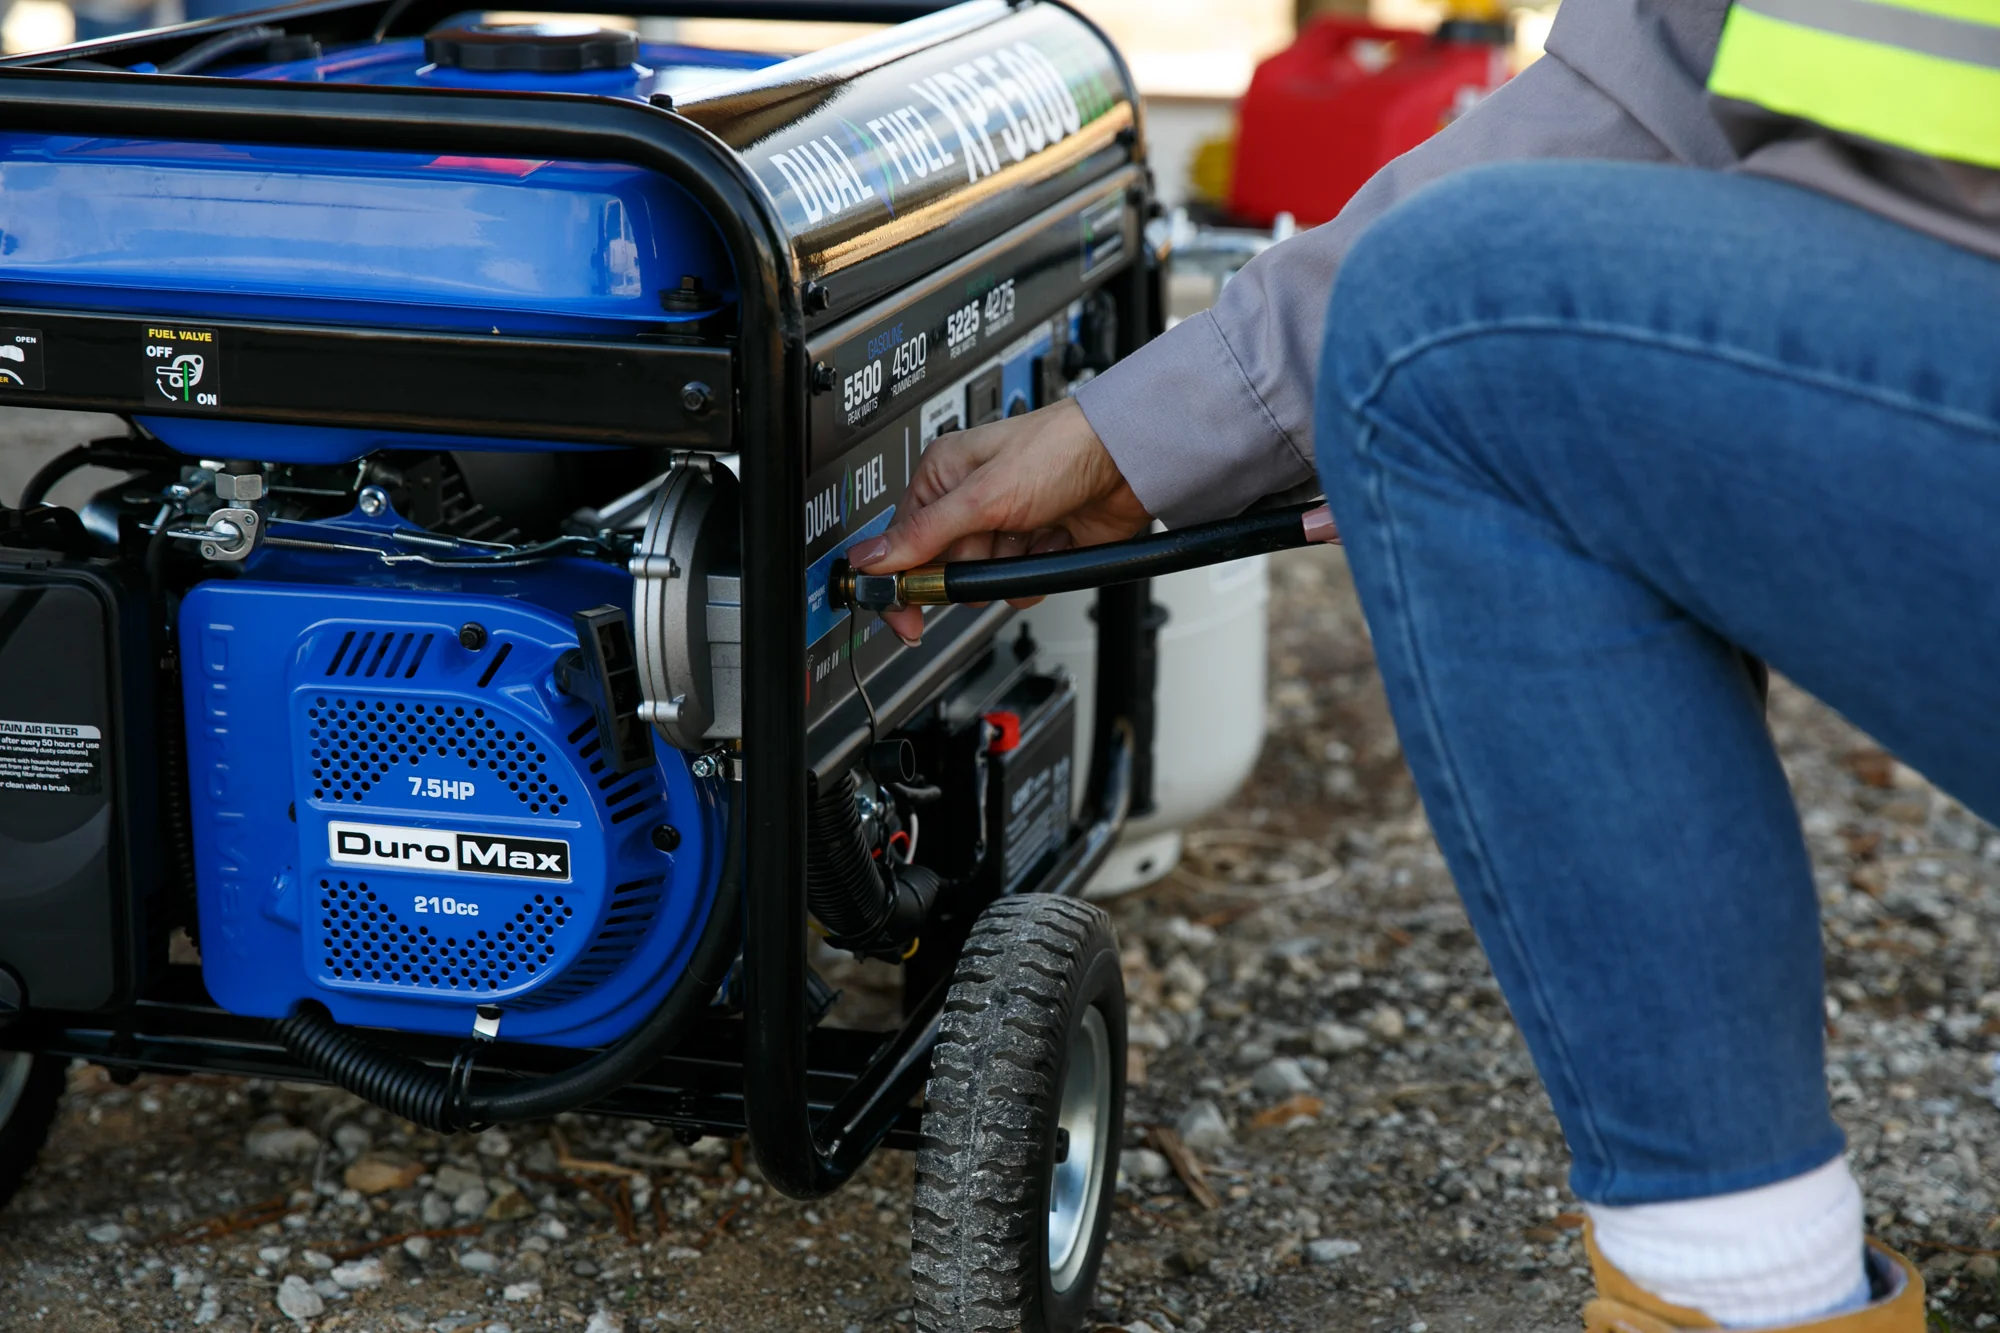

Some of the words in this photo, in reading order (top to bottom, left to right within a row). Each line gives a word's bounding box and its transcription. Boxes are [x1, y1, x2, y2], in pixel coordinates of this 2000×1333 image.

[769, 135, 874, 224] DUAL
[866, 105, 955, 186] FUEL
[947, 299, 980, 347] 5225
[984, 278, 1015, 320] 4275
[15, 335, 37, 344] OPEN
[148, 328, 177, 340] FUEL
[179, 330, 213, 343] VALVE
[868, 323, 903, 360] GASOLINE
[146, 345, 173, 358] OFF
[844, 359, 882, 411] 5500
[892, 332, 926, 379] 4500
[196, 392, 217, 405] ON
[847, 407, 861, 425] PEAK
[861, 397, 878, 417] WATTS
[805, 483, 840, 545] DUAL
[855, 453, 887, 510] FUEL
[24, 725, 43, 734] AIR
[44, 726, 79, 736] FILTER
[1, 736, 20, 745] after
[20, 739, 41, 748] every
[41, 738, 53, 747] 50
[53, 739, 76, 749] hours
[76, 741, 85, 749] of
[12, 745, 39, 754] unusually
[30, 758, 60, 766] household
[45, 766, 69, 774] housing
[5, 781, 25, 789] clean
[25, 783, 42, 791] with
[48, 784, 71, 792] brush
[408, 776, 475, 800] 7.5HP
[414, 896, 479, 916] 210cc
